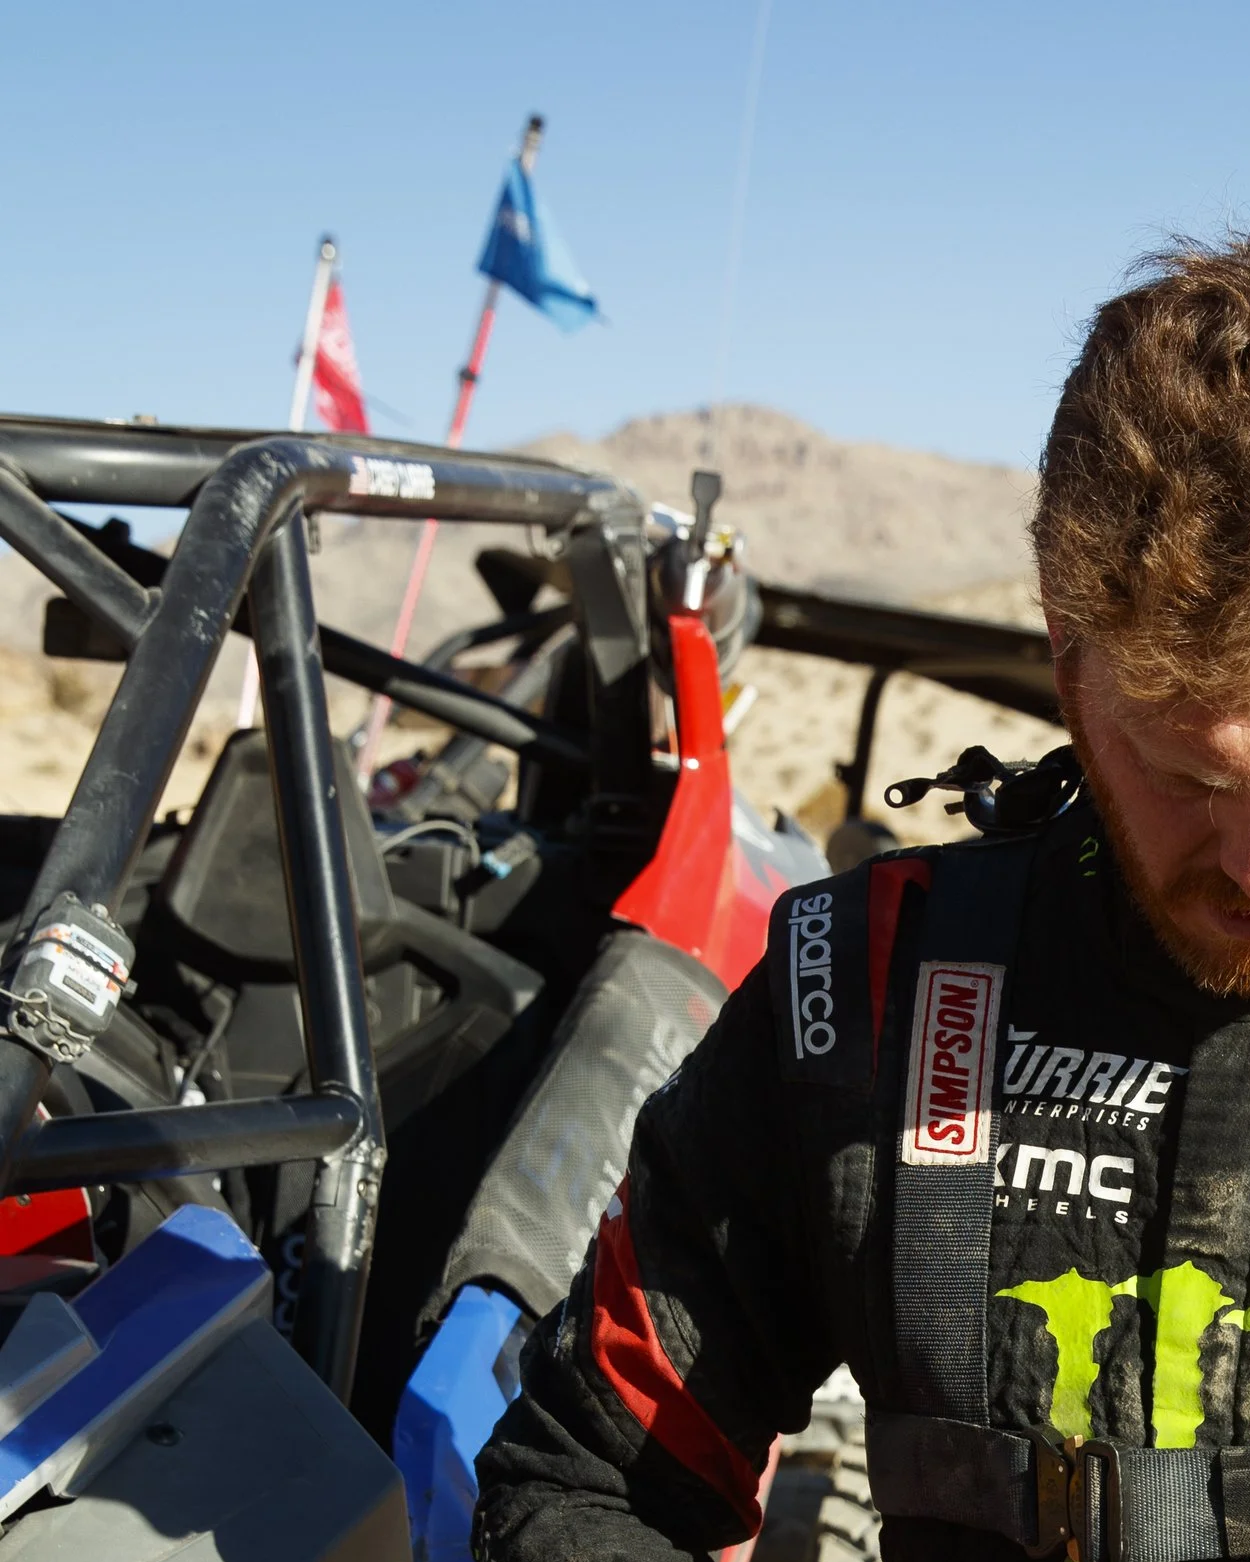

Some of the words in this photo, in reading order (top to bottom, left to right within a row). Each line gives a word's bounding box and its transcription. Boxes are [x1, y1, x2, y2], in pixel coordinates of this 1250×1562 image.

[788, 892, 836, 1059] sparco
[927, 983, 980, 1146] SIMPSON
[1003, 1025, 1189, 1114] URRIE
[1004, 1100, 1151, 1132] NTERPRISES
[995, 1194, 1129, 1224] HEELS
